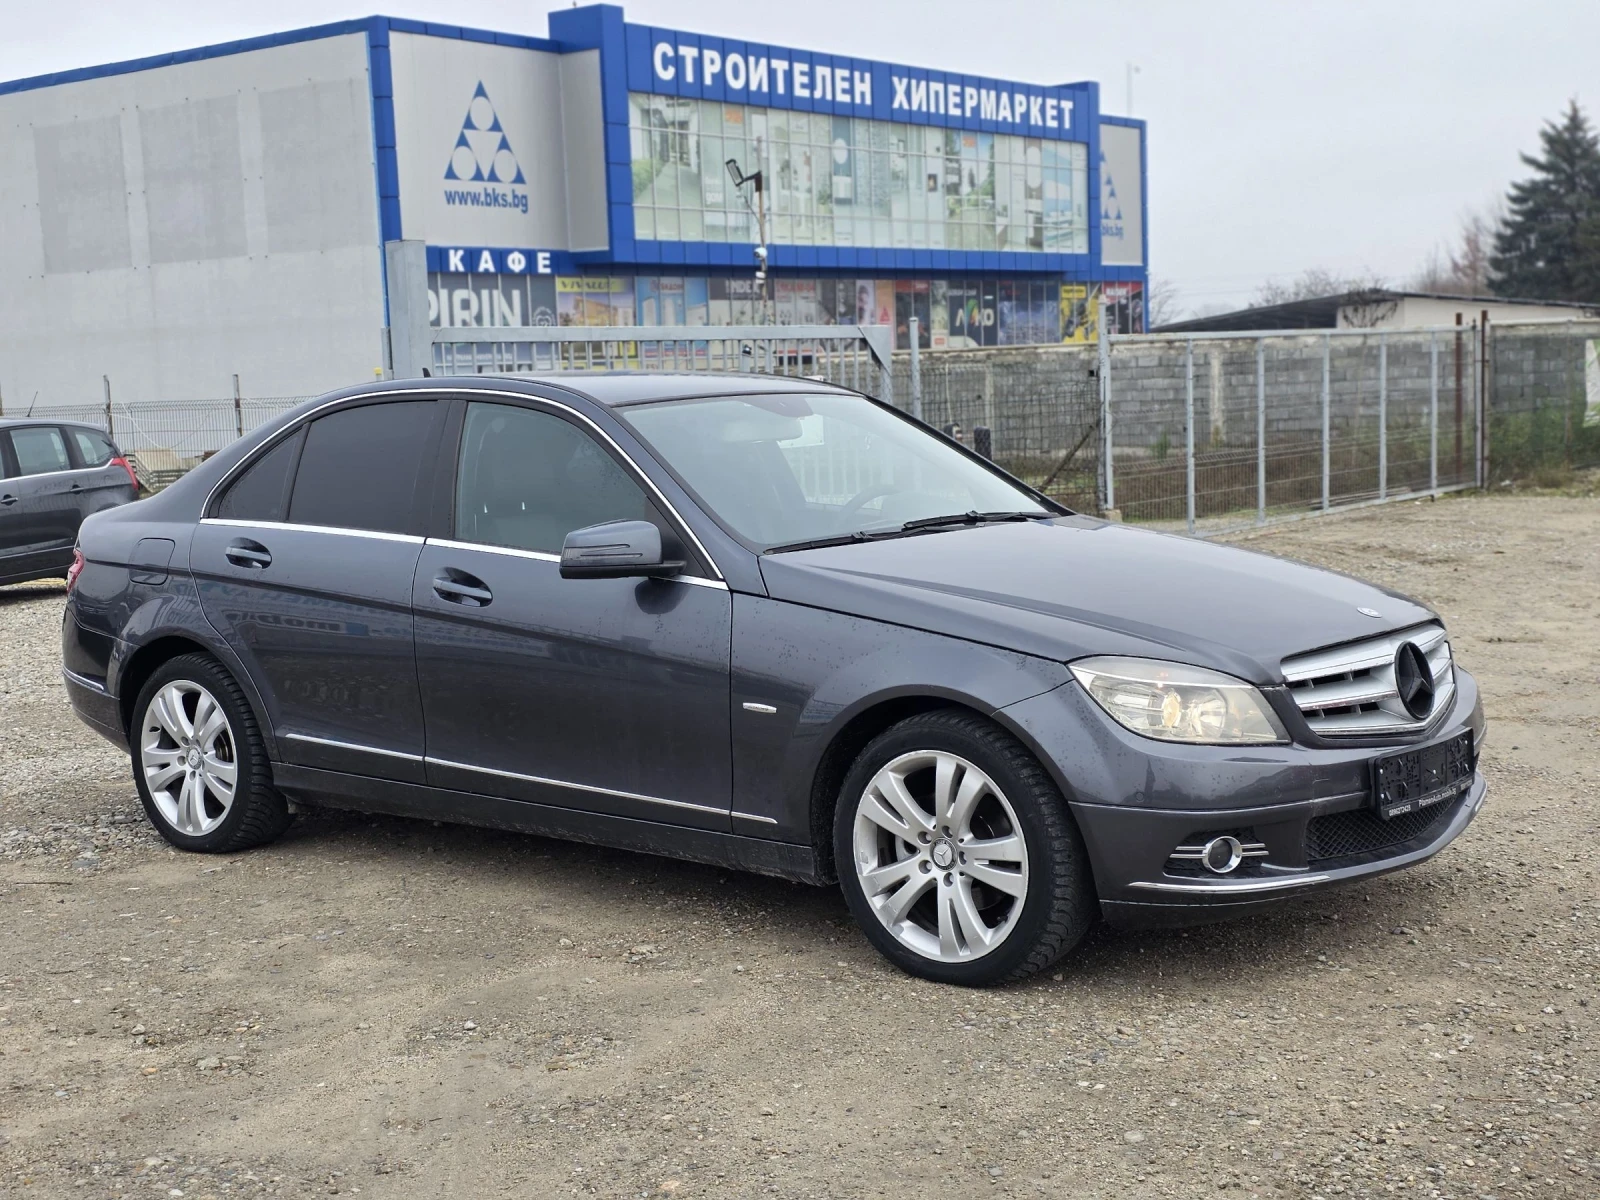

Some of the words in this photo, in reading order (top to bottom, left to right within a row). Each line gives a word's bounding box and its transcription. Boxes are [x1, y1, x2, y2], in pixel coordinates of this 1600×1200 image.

[653, 42, 872, 106] СТРОИТЕЛЕН
[891, 75, 1074, 129] ХИПЕРМАРКЕТ
[444, 187, 528, 214] www.bks.bg
[448, 249, 551, 274] КАФЕ
